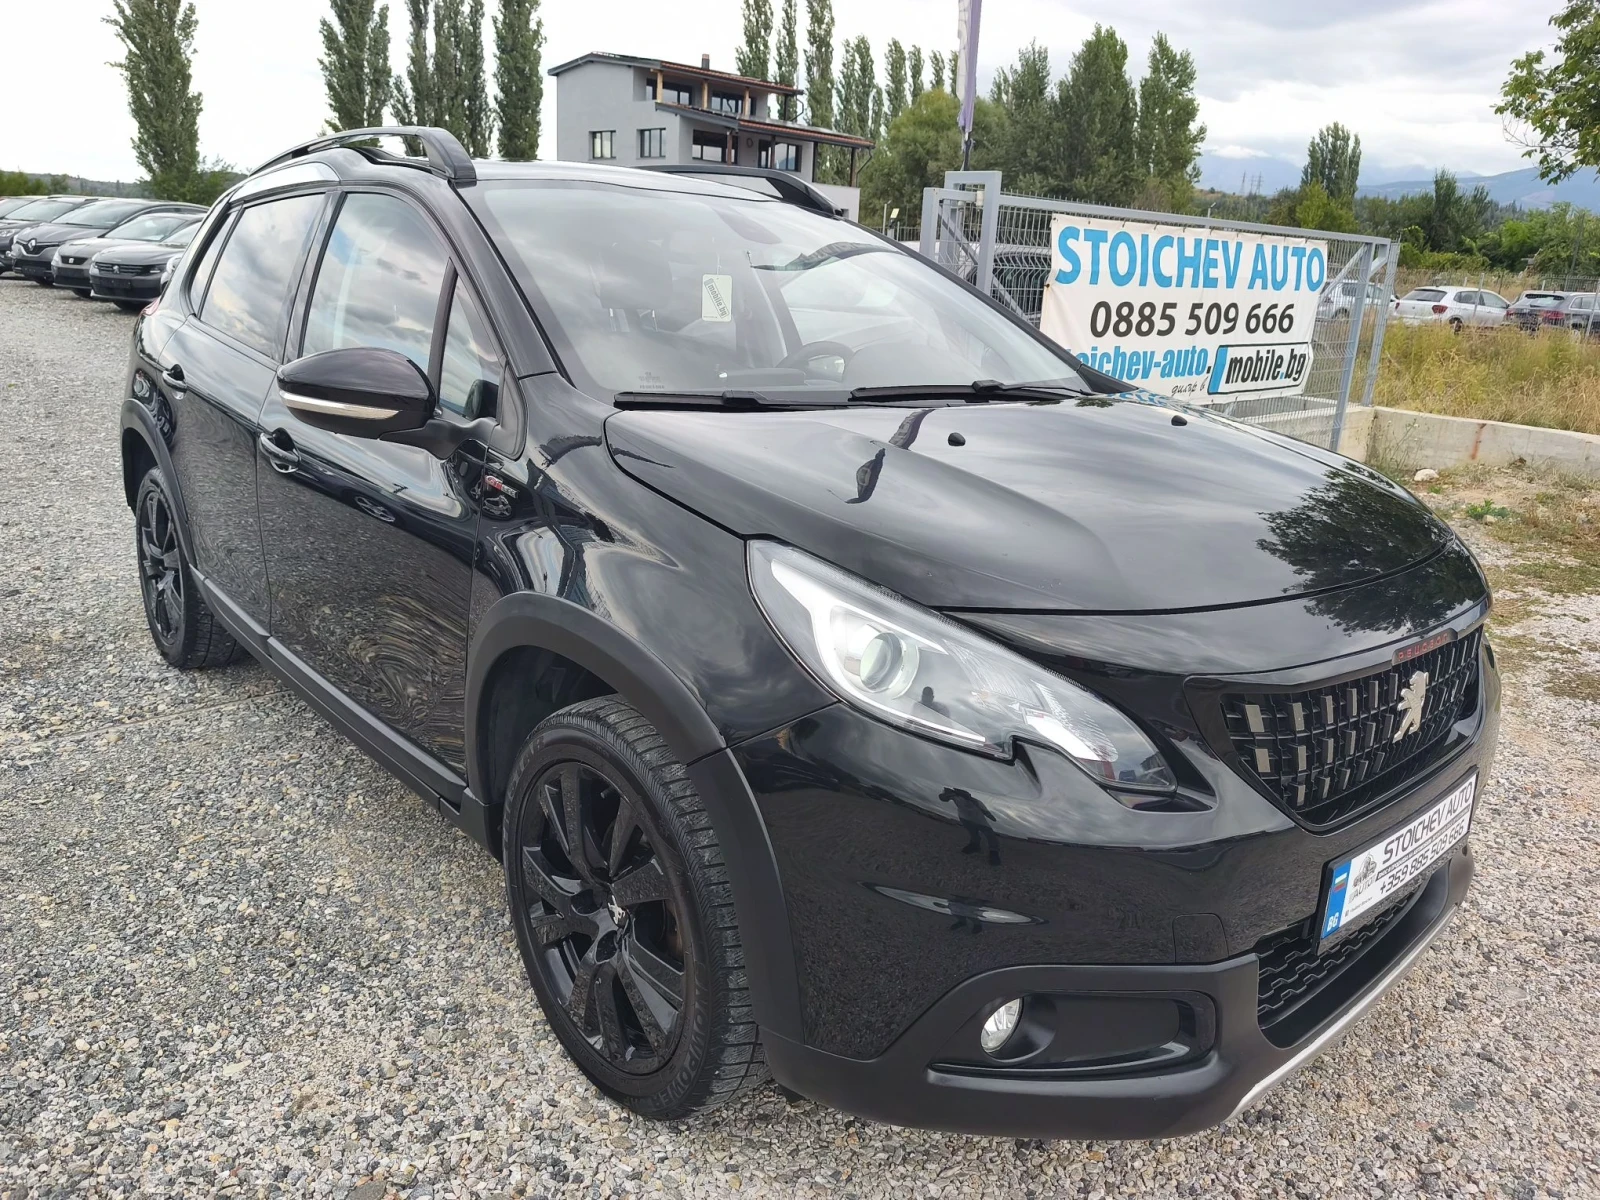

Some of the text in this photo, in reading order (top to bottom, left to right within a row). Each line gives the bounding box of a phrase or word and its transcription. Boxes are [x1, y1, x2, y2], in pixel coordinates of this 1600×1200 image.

[1055, 226, 1325, 292] STOICHEV AUTO
[1090, 301, 1295, 338] 0885 509 666
[1225, 349, 1307, 386] mobile.bg
[1398, 633, 1448, 662] PEUGEOT
[1382, 802, 1445, 865] STOICHEV
[1445, 781, 1473, 821] AUTO
[1380, 864, 1409, 895] +359
[1430, 833, 1448, 862] 509
[1448, 818, 1465, 845] 666
[1327, 912, 1339, 932] BG
